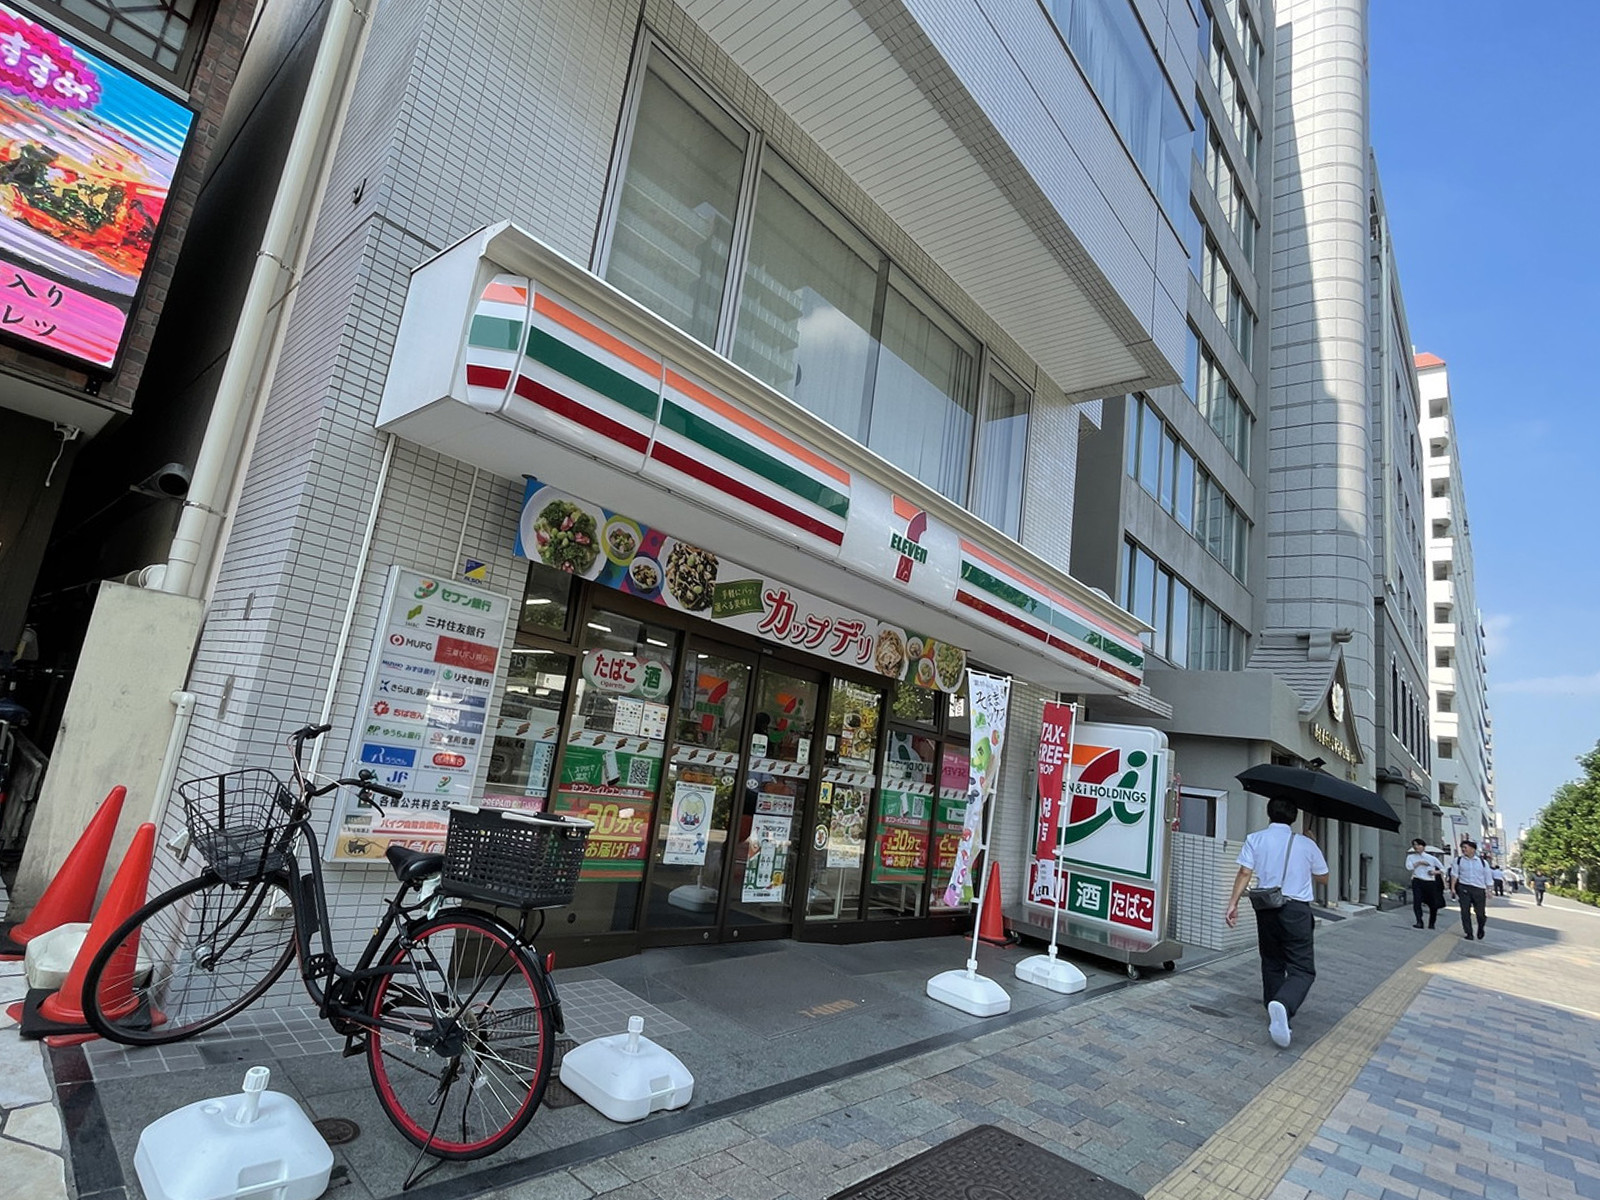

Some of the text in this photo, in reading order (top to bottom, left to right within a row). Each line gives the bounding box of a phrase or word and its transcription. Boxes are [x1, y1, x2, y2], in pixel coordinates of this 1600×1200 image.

[425, 616, 486, 639] 三井住友銀行
[759, 590, 872, 661] カップデリ
[405, 638, 432, 651] MUFG
[405, 664, 436, 676] みずほ銀行
[454, 672, 490, 687] りそな銀行
[593, 653, 637, 684] たばこ
[642, 664, 663, 691] 酒
[390, 684, 430, 697] きらぼし銀行
[600, 680, 627, 690] Cigarette
[382, 728, 421, 740] ゆうちょ銀行
[1040, 722, 1066, 745] TAX-
[1061, 781, 1146, 803] EN&i HOLDINGS
[1075, 881, 1102, 910] 酒
[1112, 889, 1152, 922] たばこ
